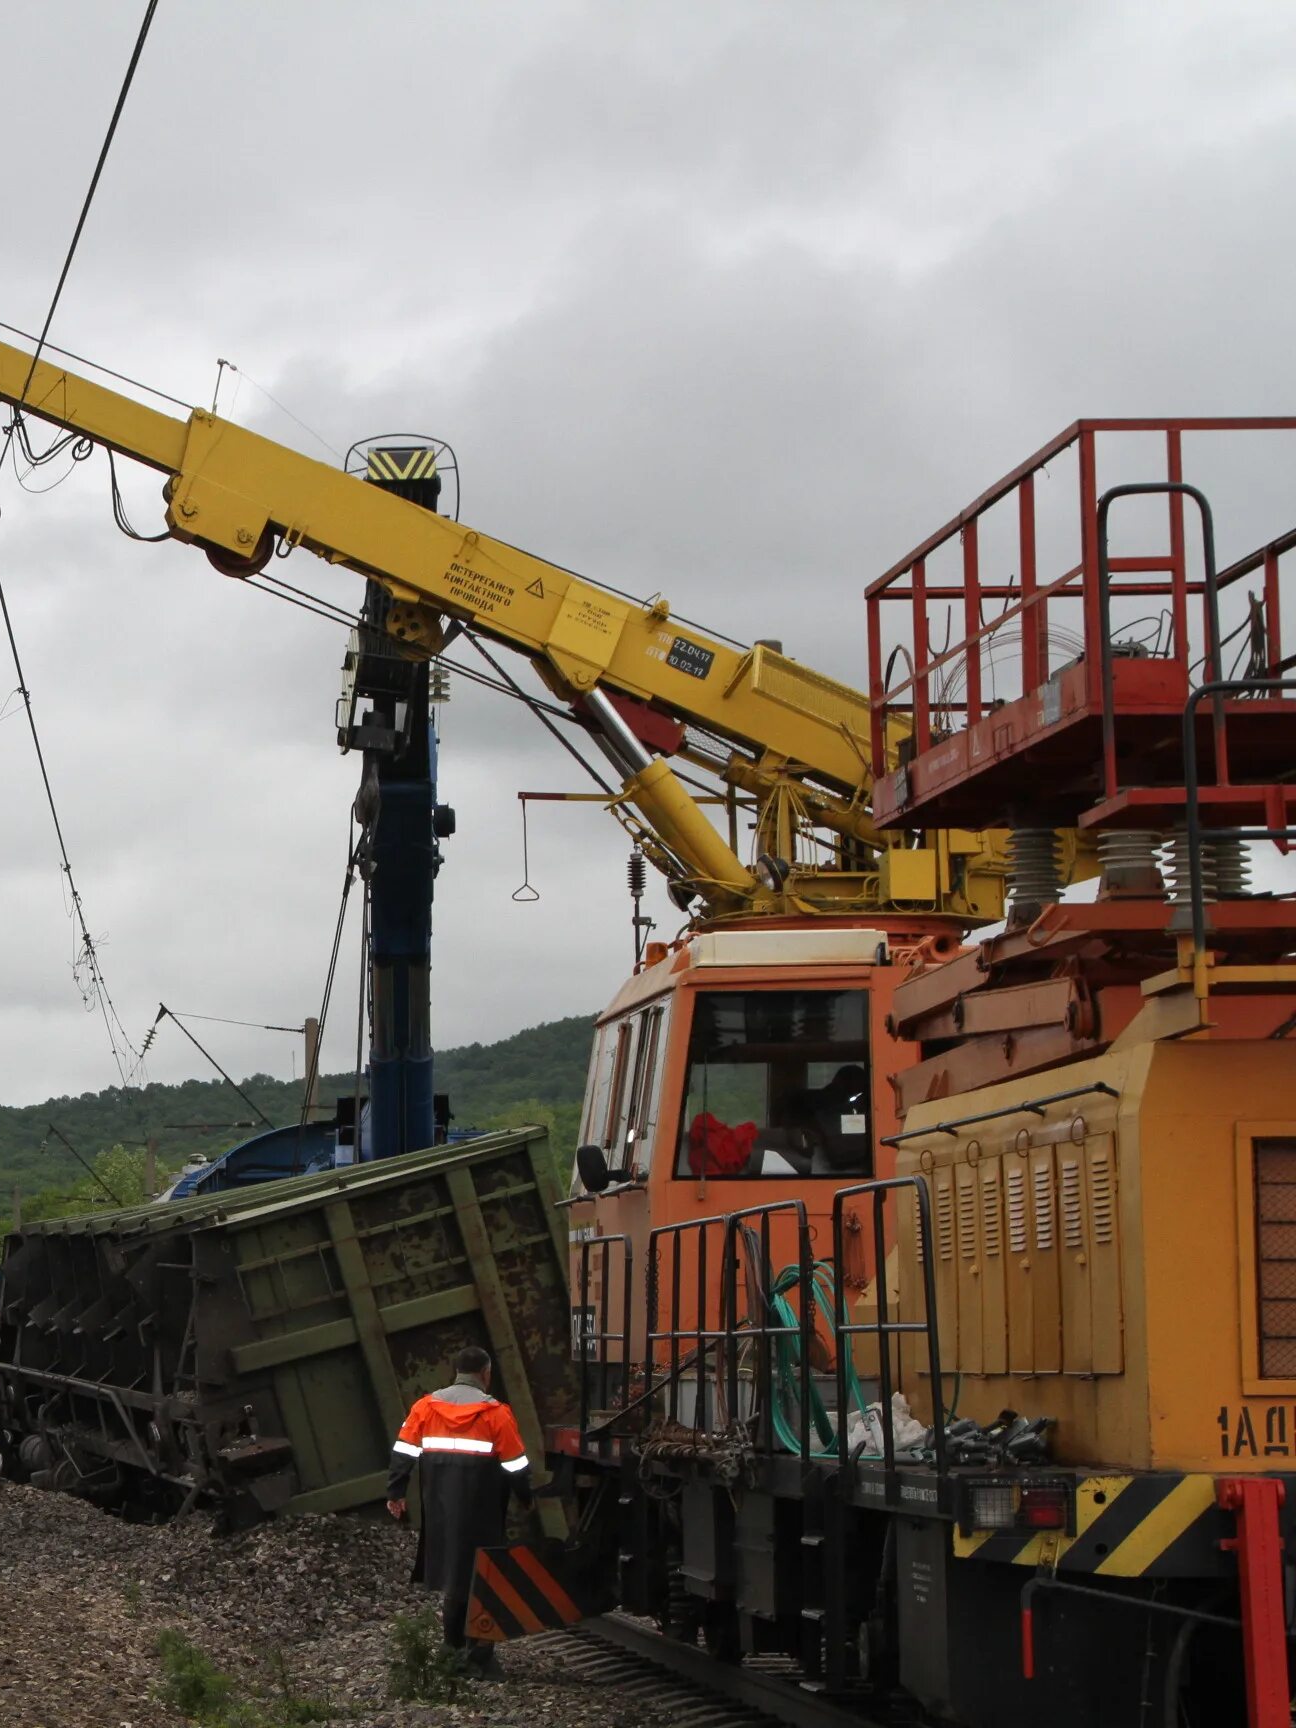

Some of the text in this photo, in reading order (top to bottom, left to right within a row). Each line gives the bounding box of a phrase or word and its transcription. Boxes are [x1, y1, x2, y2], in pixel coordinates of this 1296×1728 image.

[444, 572, 511, 607] КОНТАКТНОГО
[449, 586, 495, 612] ПРОВОДА
[674, 639, 710, 663] 22.04.17
[669, 655, 704, 677] 10.02.17
[1217, 1405, 1296, 1457] 1АД
